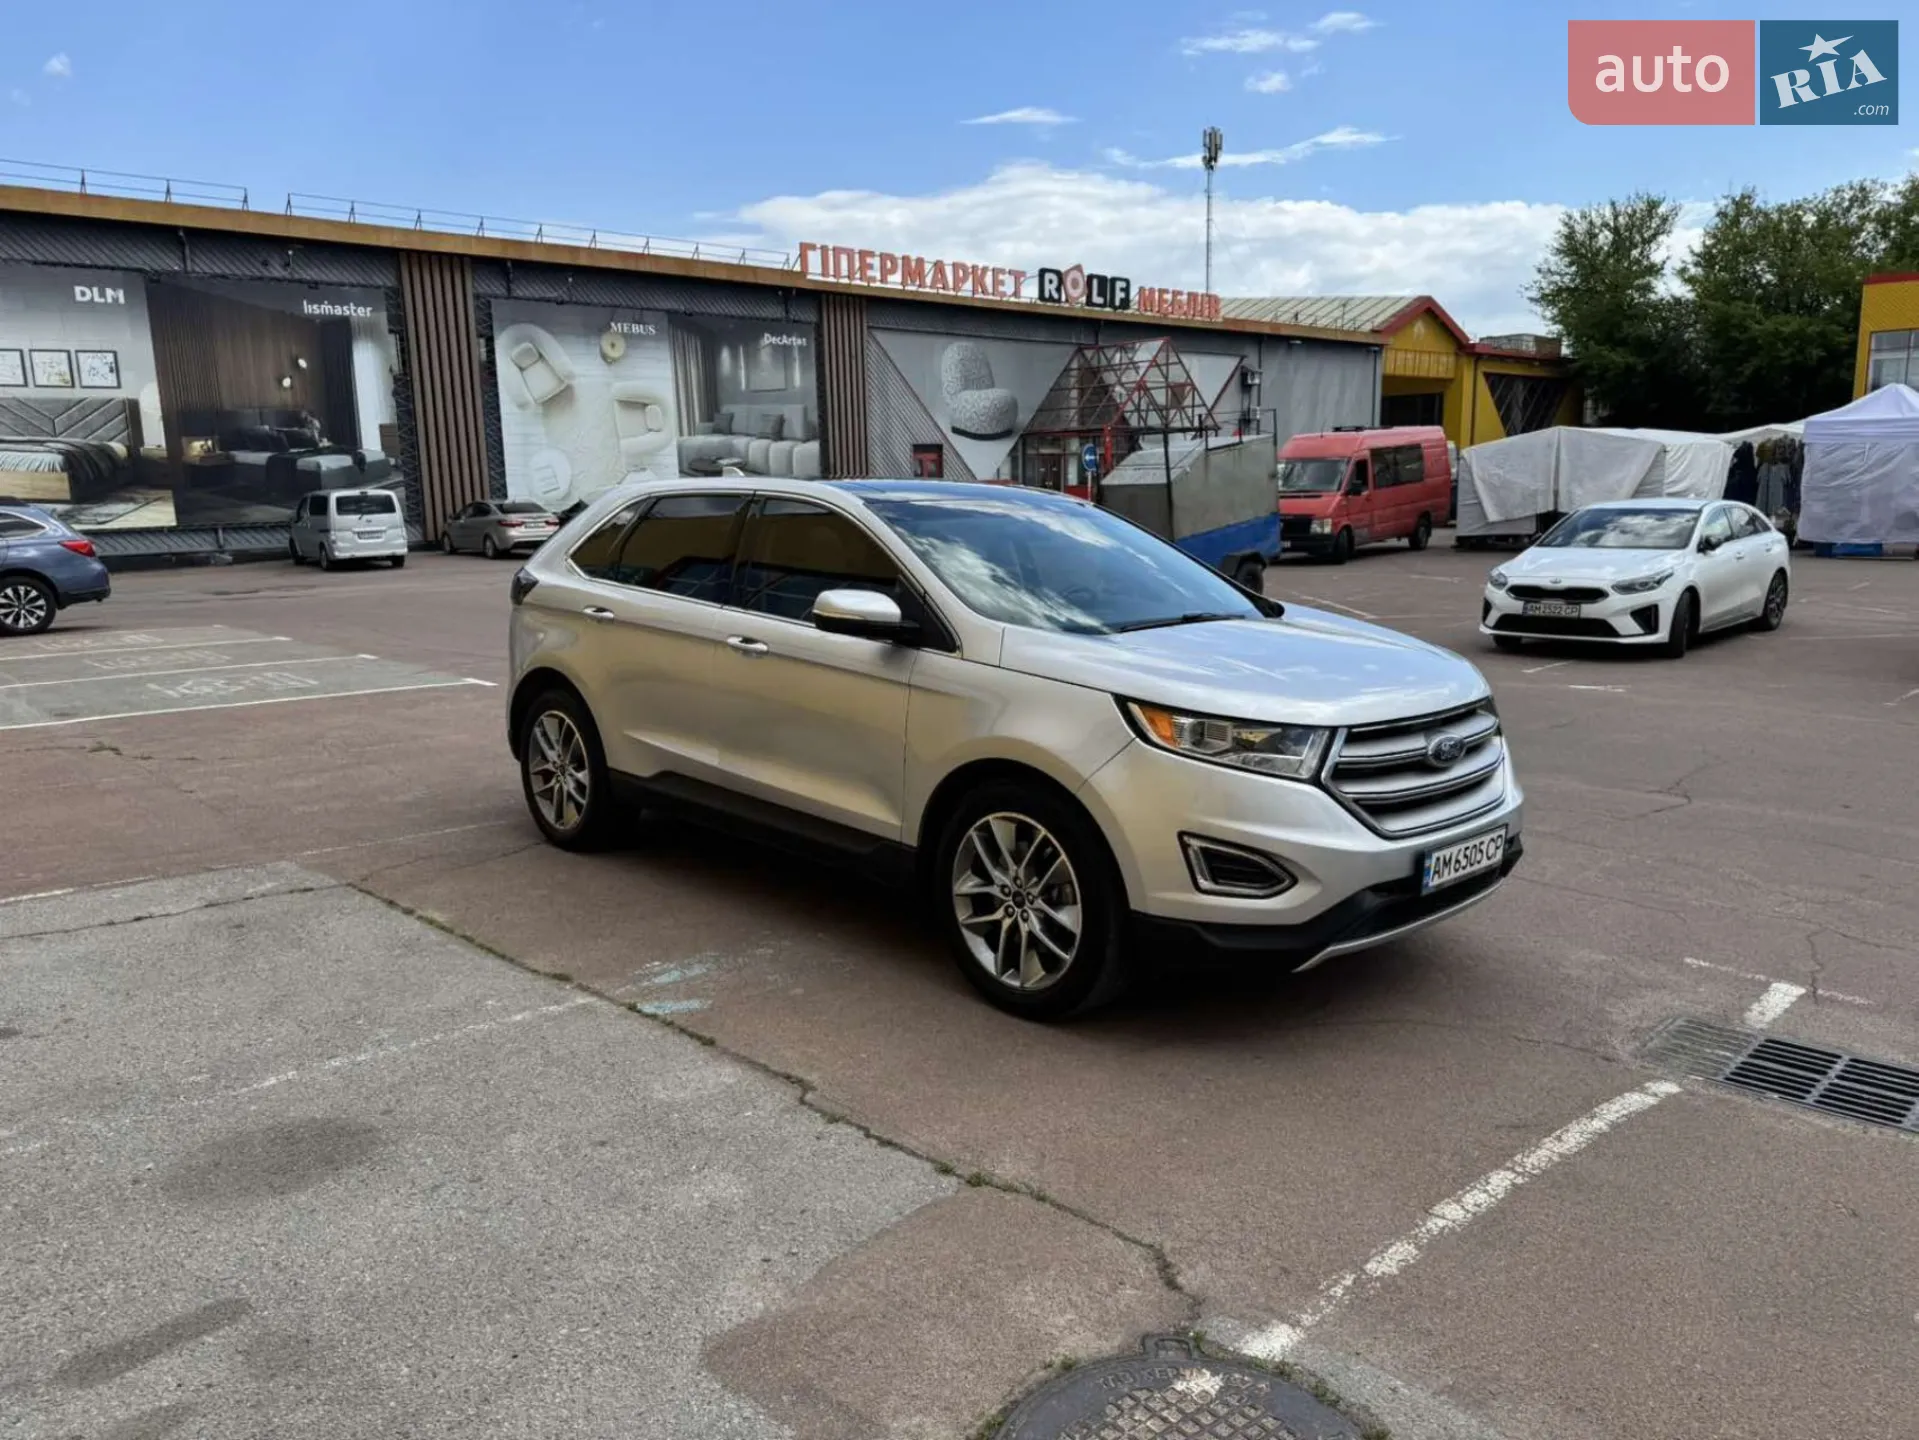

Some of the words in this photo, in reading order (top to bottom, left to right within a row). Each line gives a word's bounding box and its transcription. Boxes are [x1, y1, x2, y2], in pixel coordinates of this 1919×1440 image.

[73, 285, 125, 305] DLM
[799, 241, 1027, 298] ГІПЕРМАРКЕТ
[1042, 268, 1127, 308] ROLF
[1138, 286, 1221, 319] МЕБЛІВ
[610, 321, 656, 336] MEBUS
[1431, 851, 1453, 883] AM
[1453, 840, 1485, 873] 6505
[1486, 834, 1504, 861] CP
